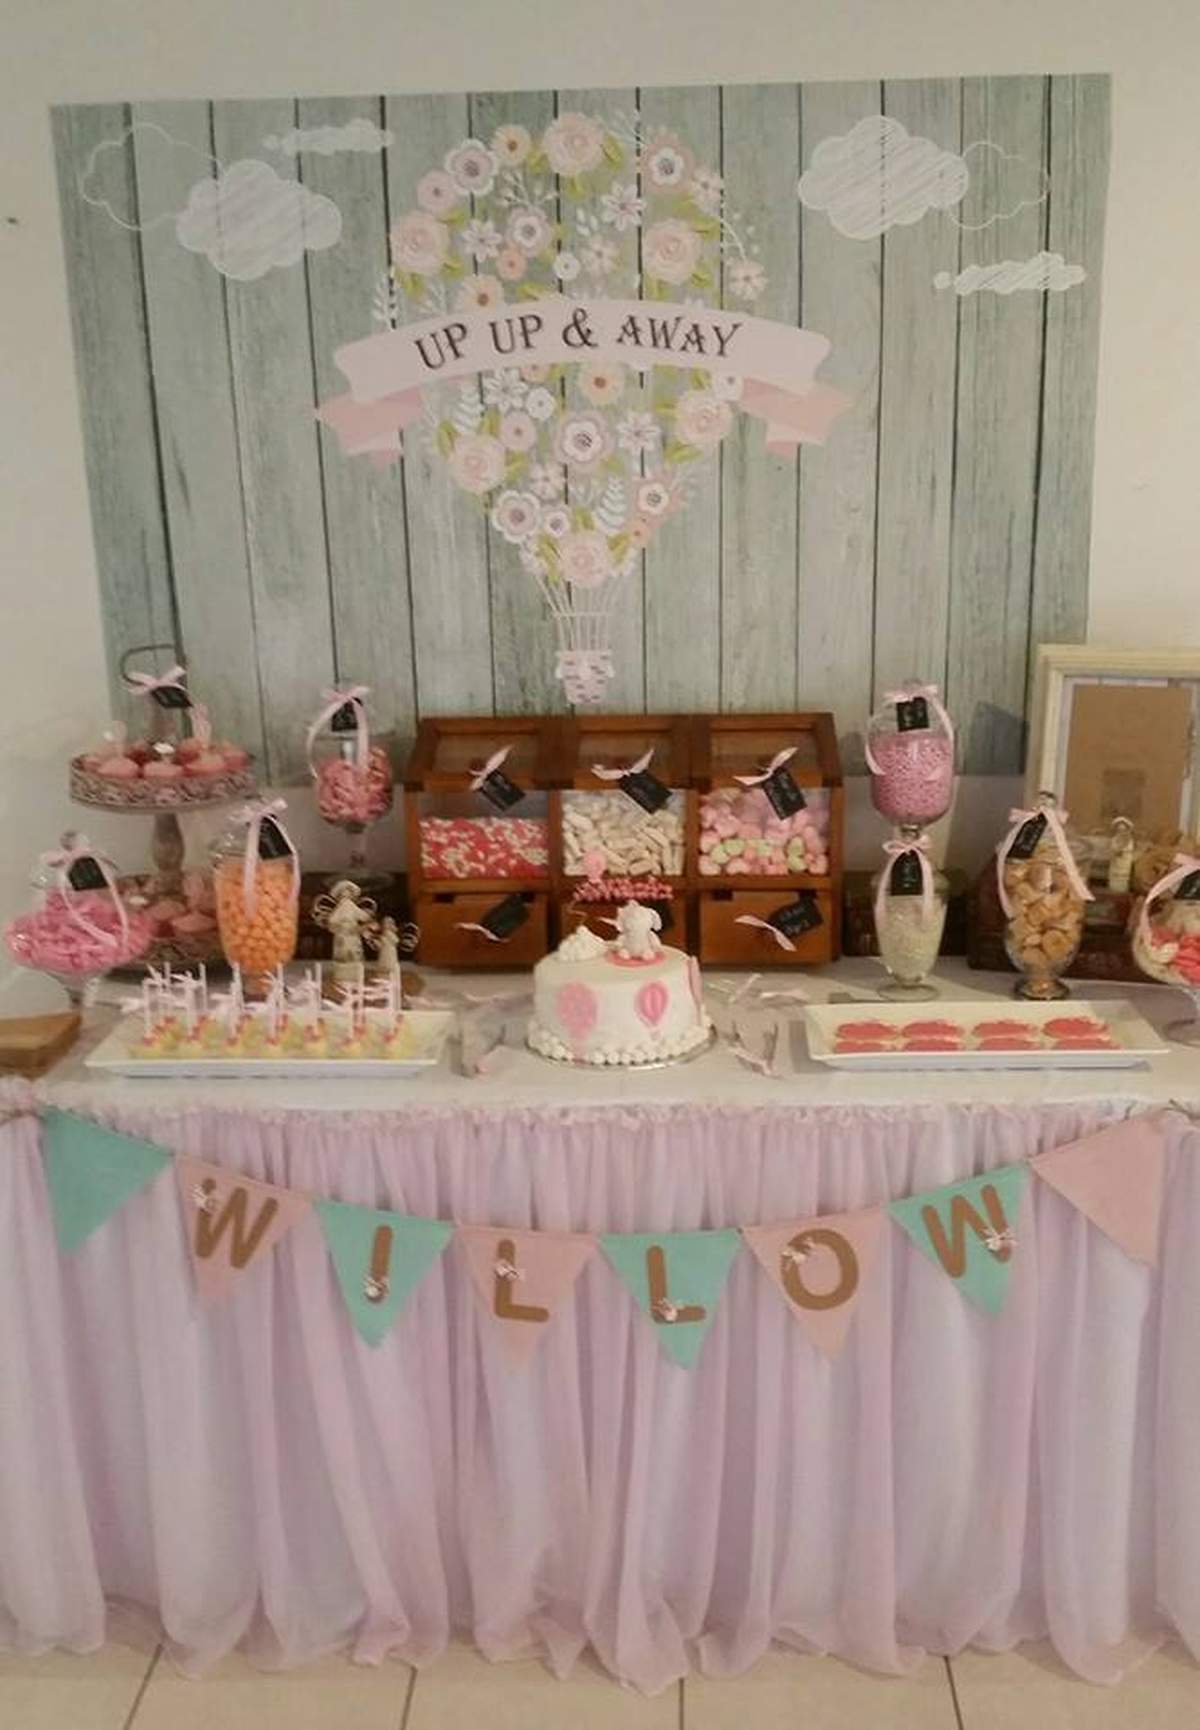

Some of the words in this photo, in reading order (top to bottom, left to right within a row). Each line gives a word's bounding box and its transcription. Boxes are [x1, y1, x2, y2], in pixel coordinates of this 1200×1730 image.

[414, 322, 468, 370] UP
[488, 313, 543, 355] UP
[561, 307, 599, 349] &
[615, 314, 743, 357] AWAY
[194, 1177, 1013, 1324] WILLOW
